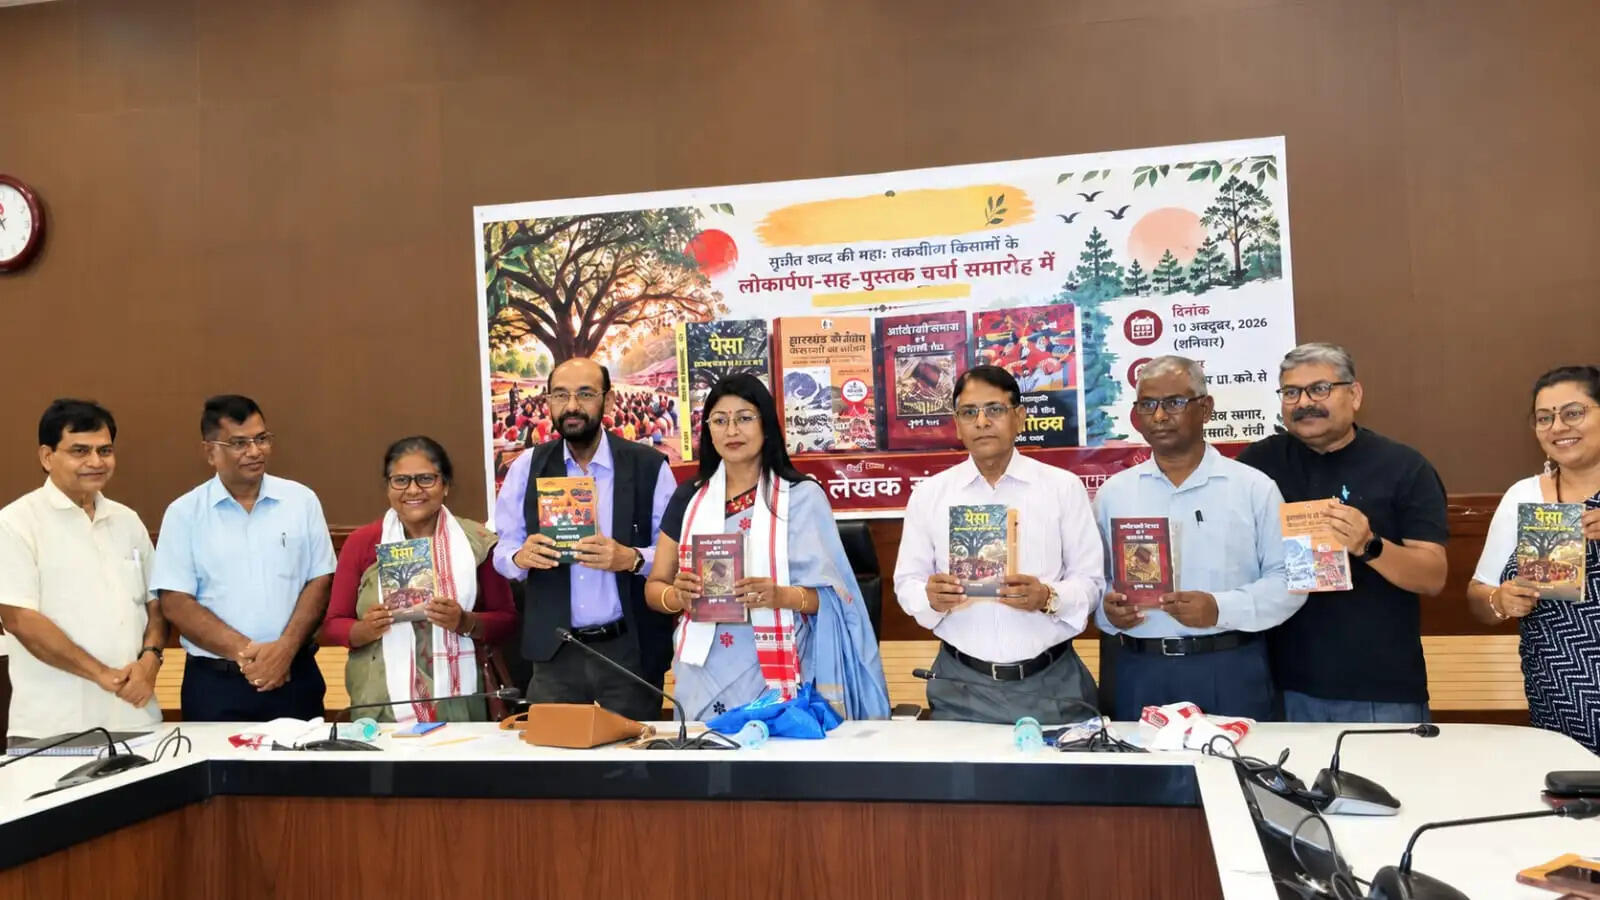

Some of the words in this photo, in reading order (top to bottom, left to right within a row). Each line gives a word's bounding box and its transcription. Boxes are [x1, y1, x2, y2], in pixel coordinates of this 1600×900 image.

[807, 253, 833, 265] शब्द
[837, 248, 854, 262] की
[1005, 235, 1019, 250] के
[738, 266, 915, 293] लोकार्पण-सह-पुस्तक
[920, 258, 958, 281] चर्चा
[964, 254, 1033, 277] समारोह
[1039, 251, 1055, 271] में
[1172, 303, 1210, 318] दिनांक
[1173, 323, 1186, 333] 10
[1238, 317, 1267, 330] 2026
[1173, 336, 1225, 351] (शनिवार)
[828, 470, 902, 499] लेखक
